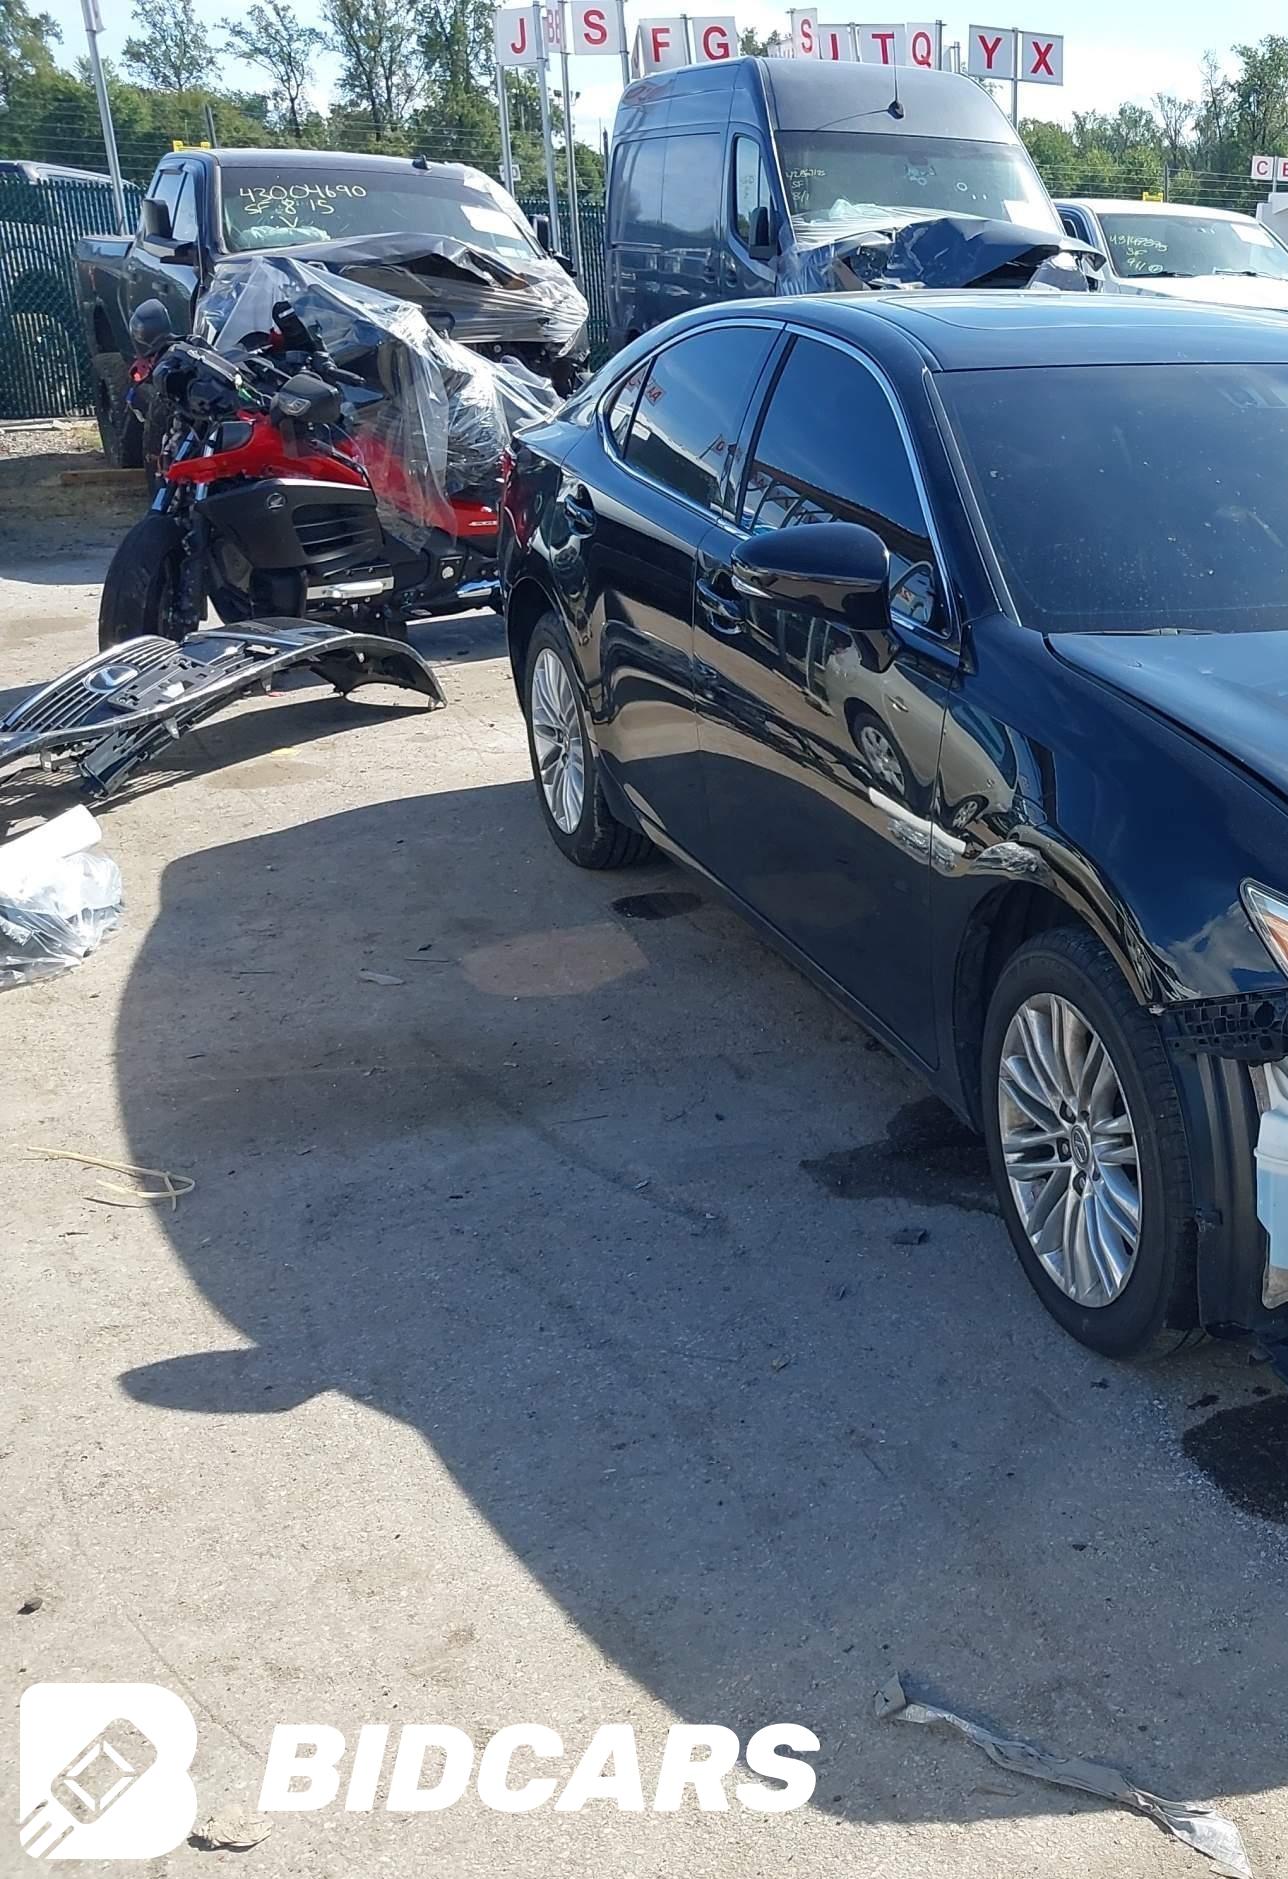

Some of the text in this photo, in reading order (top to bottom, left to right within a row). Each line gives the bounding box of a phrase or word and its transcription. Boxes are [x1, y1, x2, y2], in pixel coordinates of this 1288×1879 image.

[510, 17, 526, 55] J
[583, 9, 608, 46] S
[651, 27, 670, 63] F
[702, 25, 730, 61] G
[800, 18, 814, 54] S
[871, 33, 895, 65] T
[911, 31, 932, 68] Q
[977, 34, 1003, 70] Y
[1029, 41, 1055, 76] X
[1256, 160, 1268, 176] C
[240, 184, 367, 202] 43004690
[281, 198, 297, 215] 8
